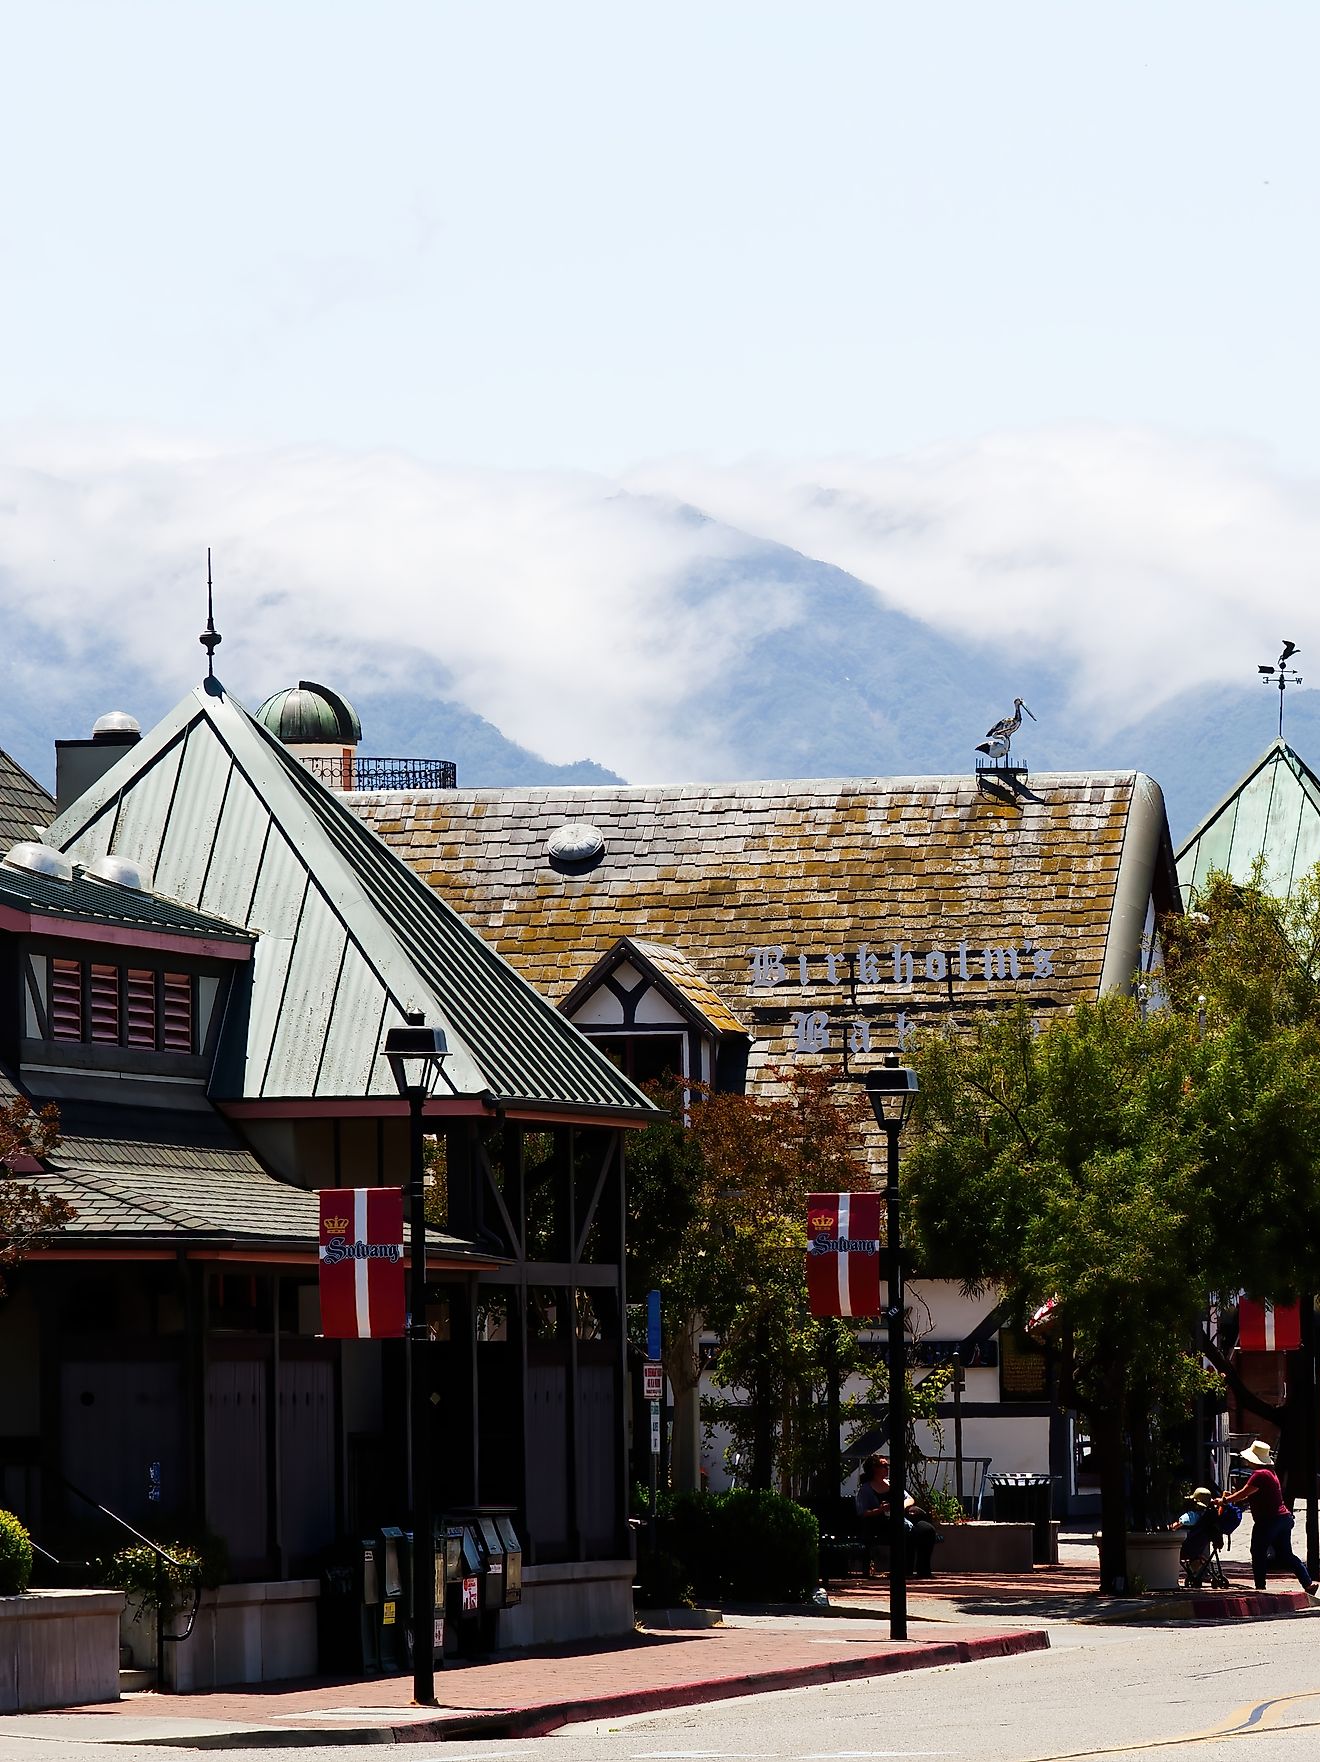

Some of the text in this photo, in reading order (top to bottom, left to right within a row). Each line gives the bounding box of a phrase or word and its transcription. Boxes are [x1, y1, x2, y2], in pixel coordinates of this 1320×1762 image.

[747, 940, 1055, 991] Birkholm's
[324, 1237, 400, 1264] Solvang
[811, 1233, 876, 1256] Solvang
